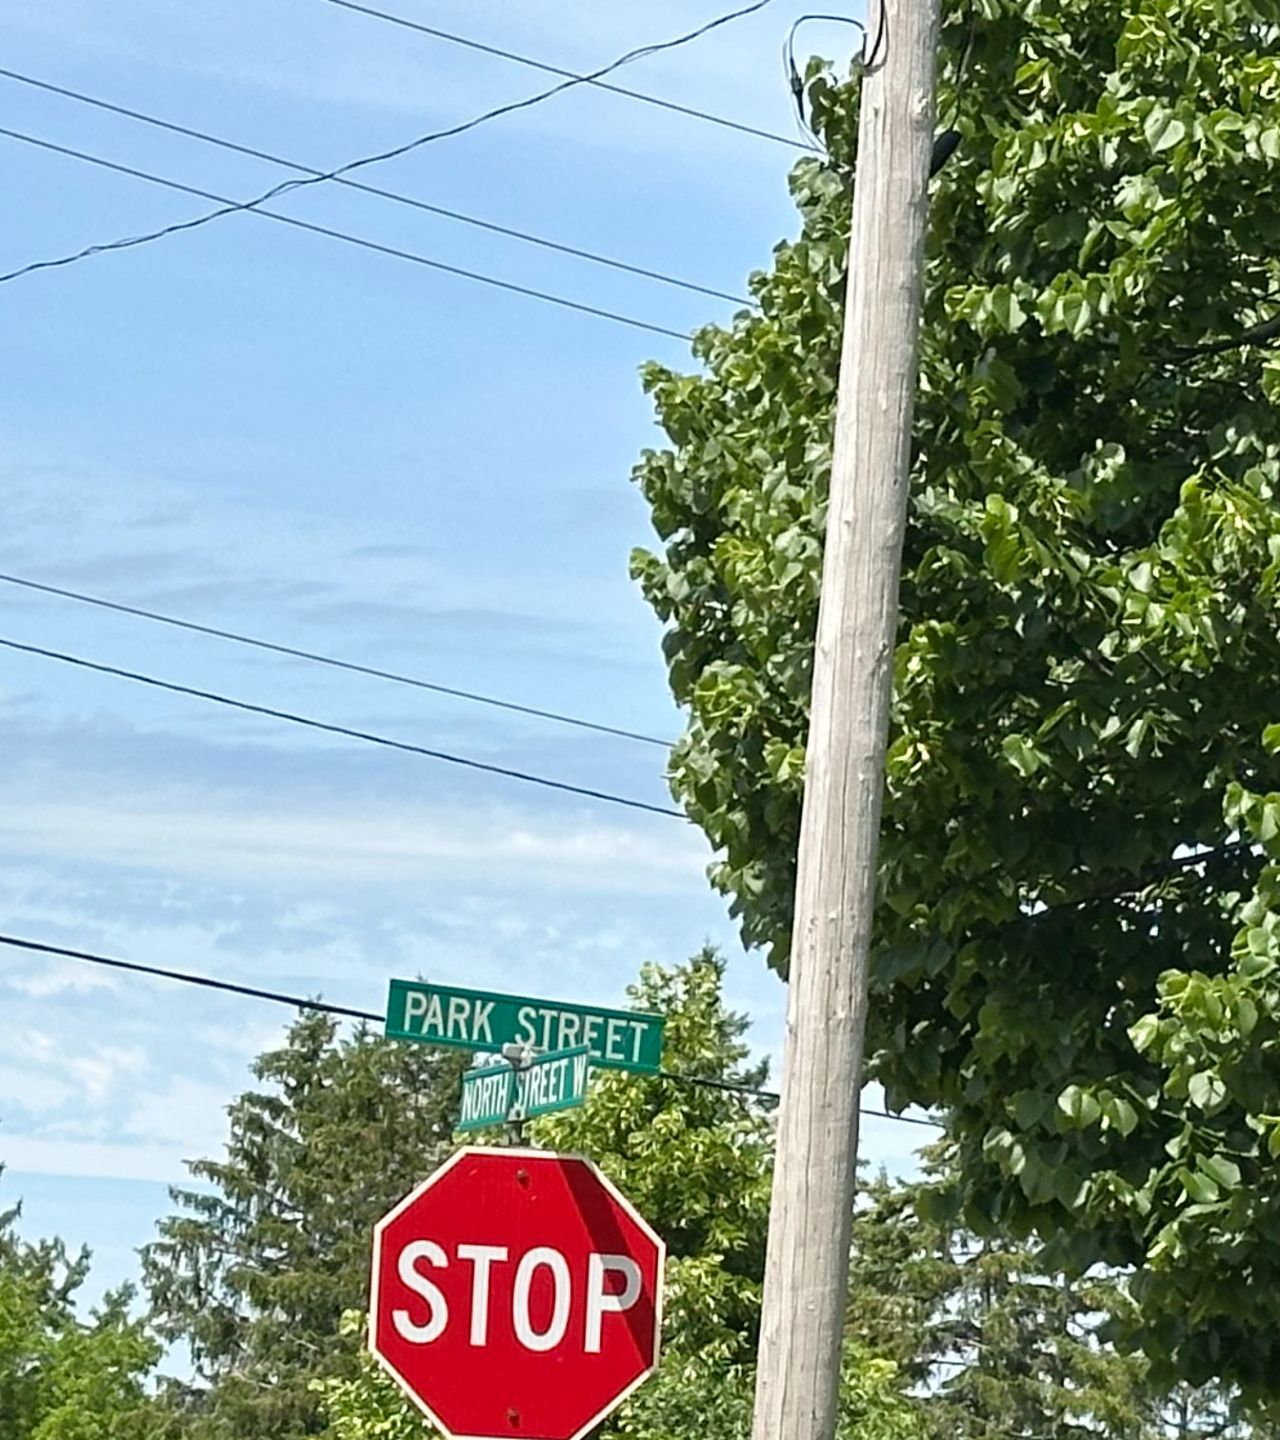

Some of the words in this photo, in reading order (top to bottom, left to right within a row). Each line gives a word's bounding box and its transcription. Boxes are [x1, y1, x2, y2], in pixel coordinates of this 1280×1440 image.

[403, 991, 494, 1043] PARK
[515, 1005, 648, 1063] STREET
[461, 1071, 508, 1121] NORTH
[515, 1058, 568, 1109] STREET
[572, 1053, 587, 1098] W
[392, 1239, 642, 1353] STOP
